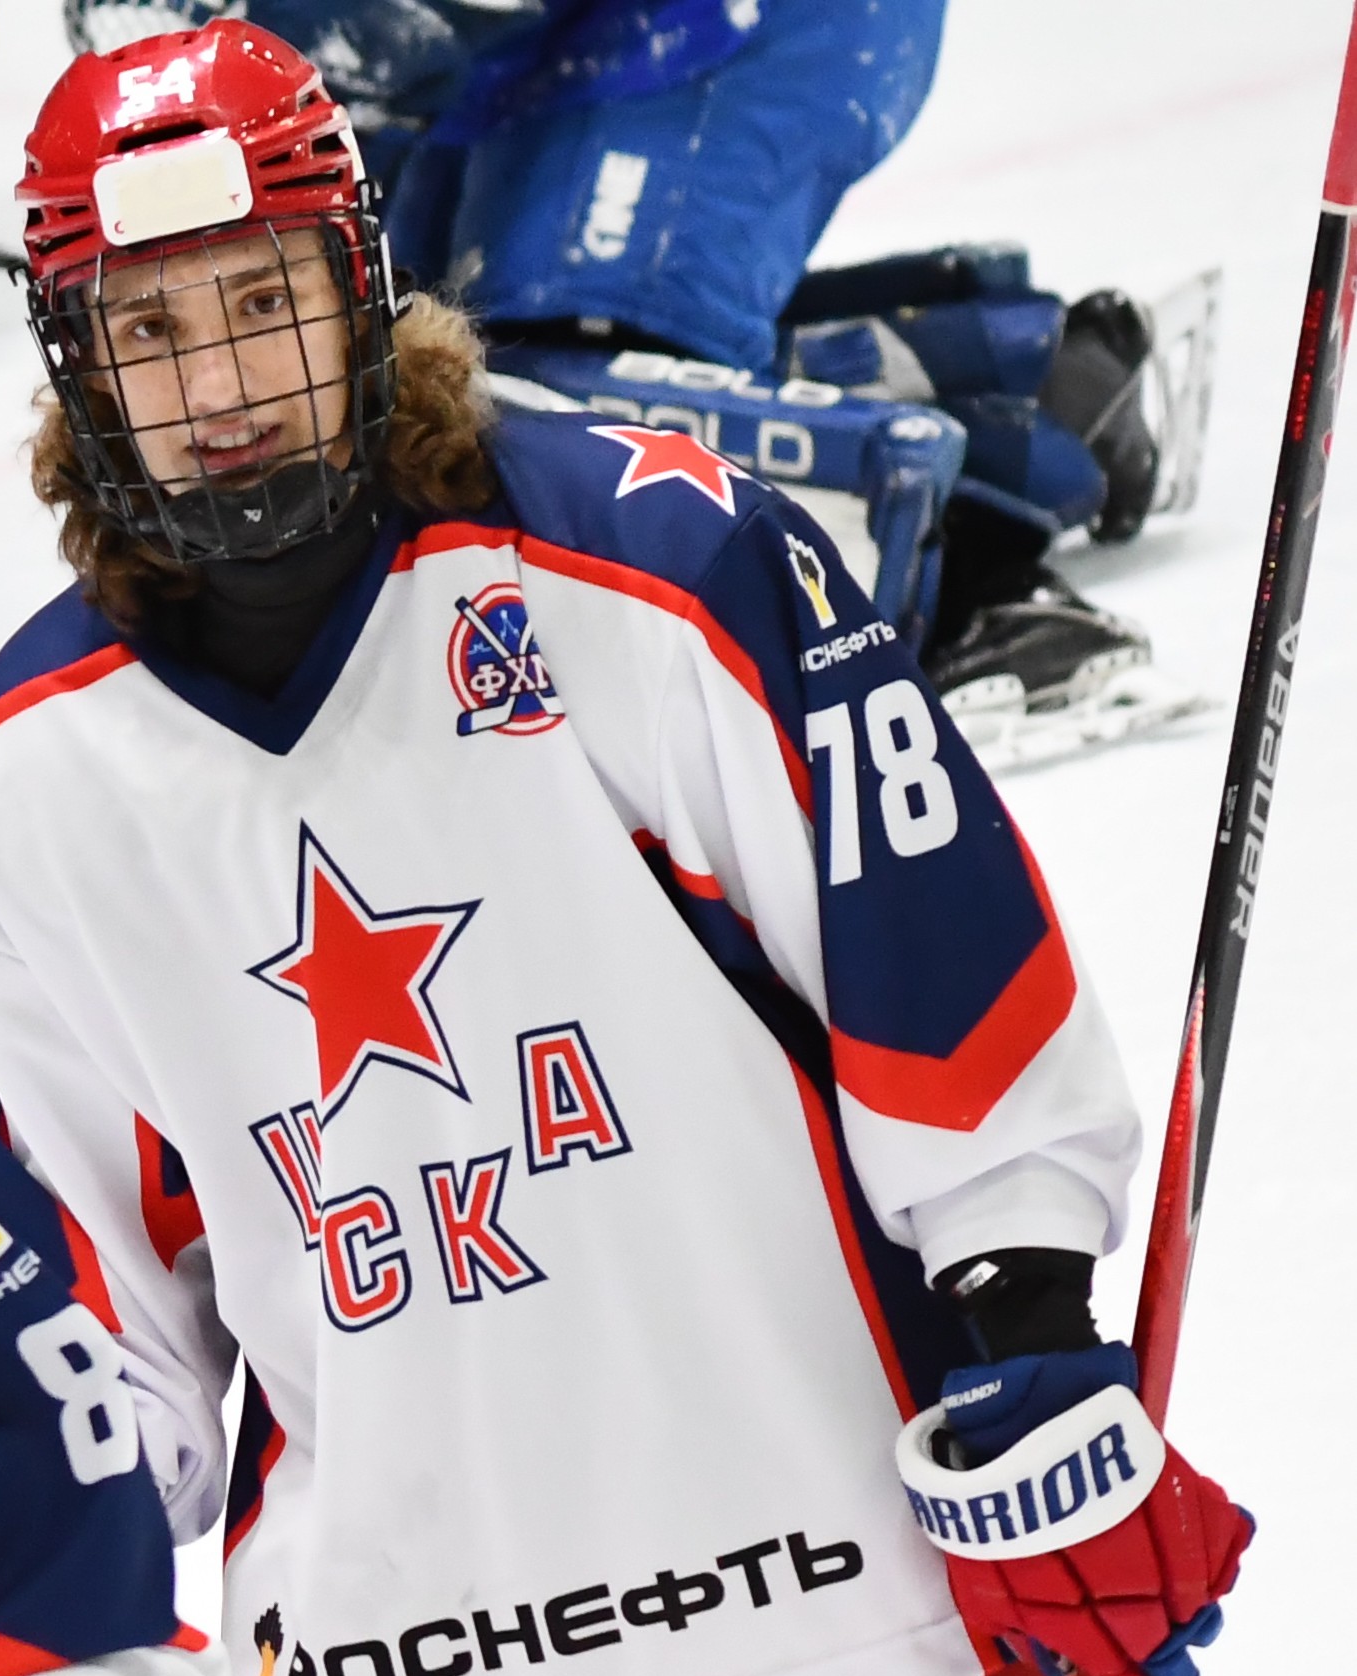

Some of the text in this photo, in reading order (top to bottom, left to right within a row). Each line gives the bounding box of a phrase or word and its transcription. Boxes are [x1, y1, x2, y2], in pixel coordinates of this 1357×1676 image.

[116, 57, 197, 118] 54
[608, 349, 844, 408] BOLD
[800, 620, 897, 673] СНЕФТЬ
[805, 679, 959, 886] 78
[905, 1422, 1137, 1545] ARRIOR
